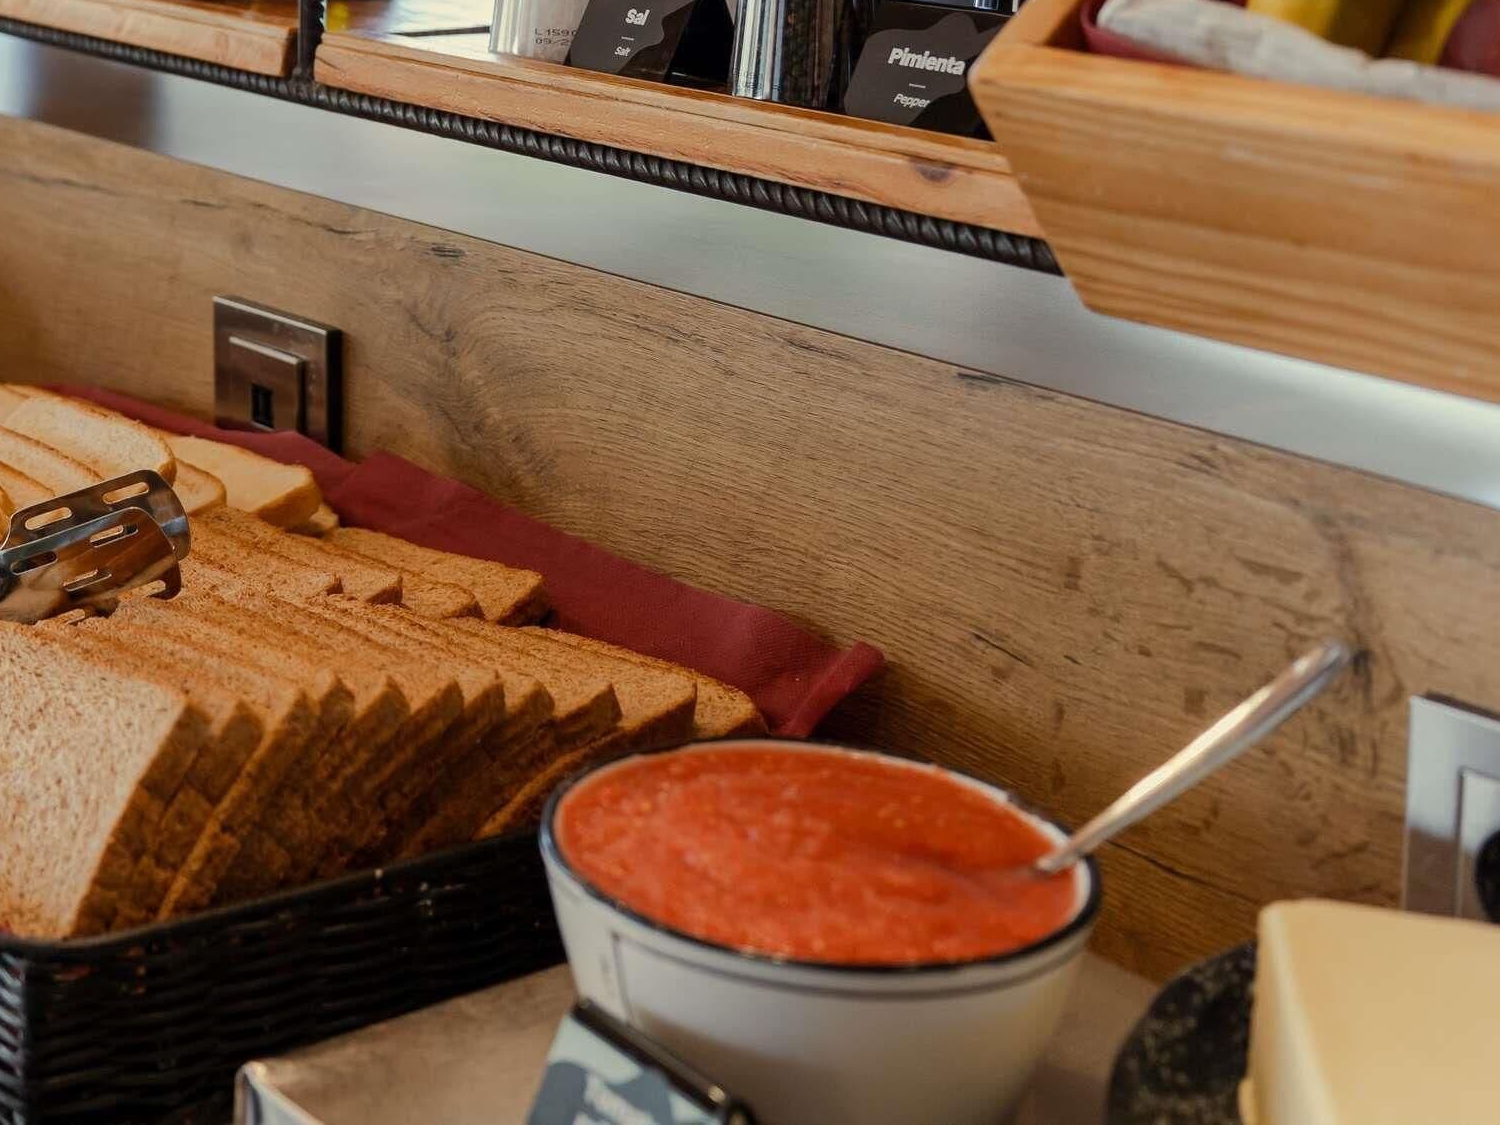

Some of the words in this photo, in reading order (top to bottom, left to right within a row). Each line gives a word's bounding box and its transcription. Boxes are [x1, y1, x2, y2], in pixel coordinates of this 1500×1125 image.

[625, 8, 651, 26] Sal
[614, 46, 631, 57] Salt
[887, 47, 966, 75] Pimienta
[893, 93, 930, 108] Pepper
